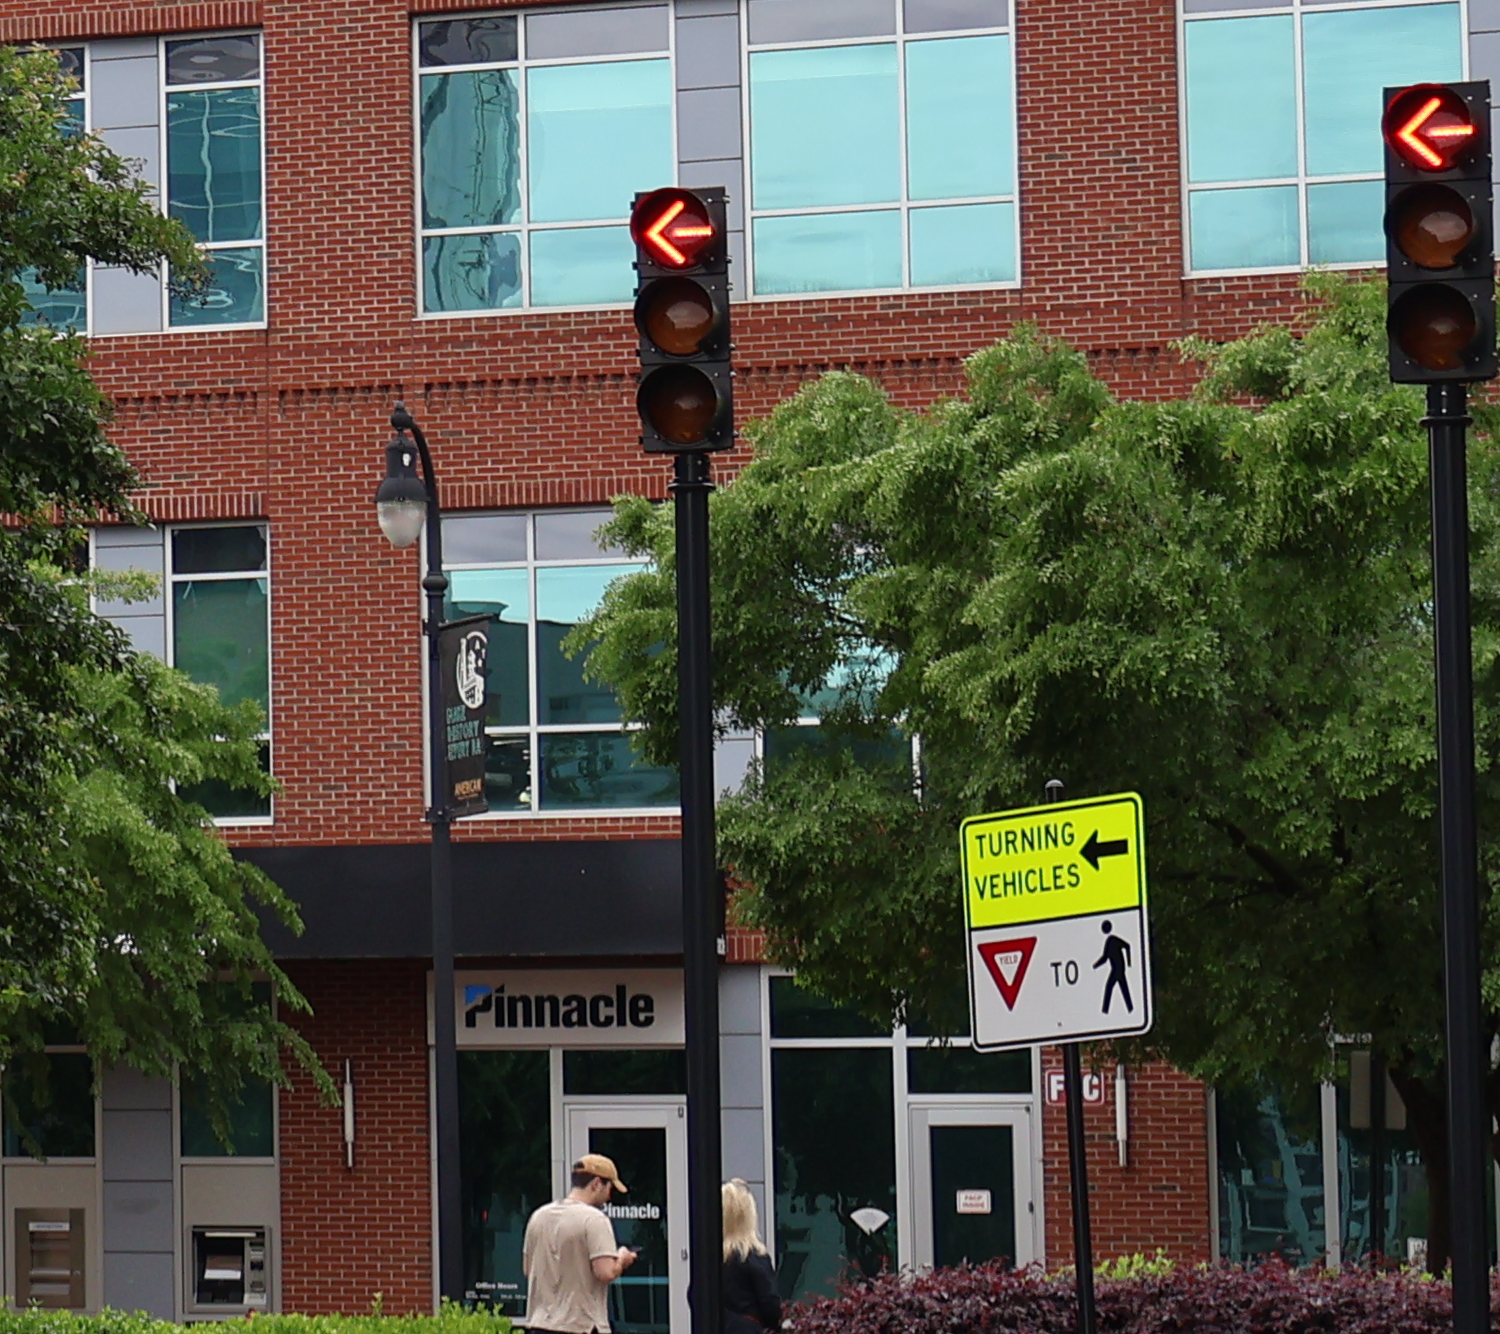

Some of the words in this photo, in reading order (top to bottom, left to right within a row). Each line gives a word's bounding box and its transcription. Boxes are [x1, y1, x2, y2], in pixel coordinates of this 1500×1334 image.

[975, 821, 1075, 859] TURNING
[974, 863, 1081, 900] VEHICLES
[999, 954, 1018, 965] YIELD
[1050, 960, 1079, 987] TO
[465, 984, 654, 1028] Pinnacle
[1050, 1074, 1099, 1101] FC
